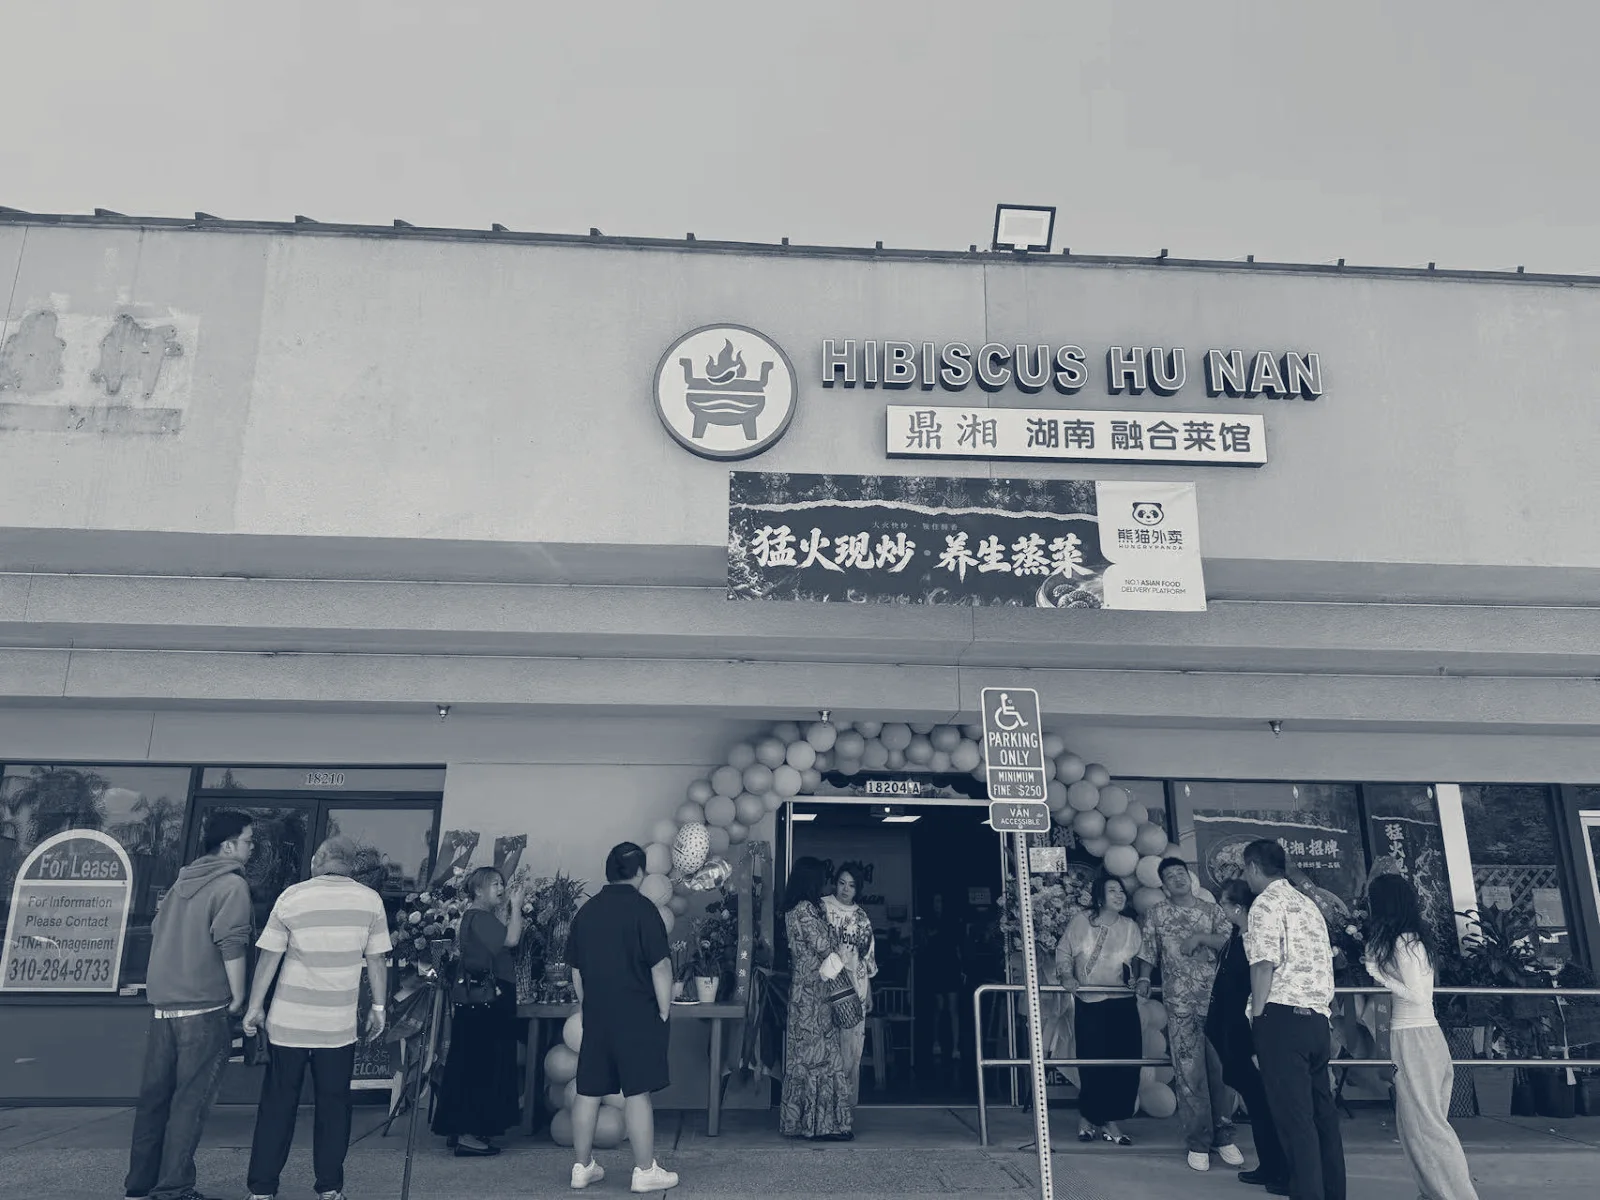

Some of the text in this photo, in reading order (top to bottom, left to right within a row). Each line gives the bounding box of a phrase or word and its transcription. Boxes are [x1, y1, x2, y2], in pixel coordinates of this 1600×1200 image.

[822, 339, 1324, 398] HIBISCUS HU NAN
[905, 409, 998, 450] 鼎湘
[1026, 417, 1096, 450] 湖南
[1118, 529, 1183, 544] 熊猫外卖
[751, 524, 1098, 584] 猛火现炒 养生蒸菜
[1152, 587, 1186, 595] PLATFORM
[988, 732, 1038, 748] PARKING
[1000, 749, 1030, 766] ONLY
[306, 772, 345, 786] 18210
[998, 772, 1035, 783] MINIMUM
[868, 782, 907, 793] 18204
[993, 784, 1042, 797] FINE $250
[1009, 808, 1030, 818] VAN
[1000, 818, 1040, 826] ACCESSIBLE
[38, 853, 119, 878] For Lease
[28, 895, 112, 908] For Information
[25, 915, 109, 927] Please Contact
[13, 935, 114, 952] JTNA Management
[9, 958, 110, 981] 310-284-8733
